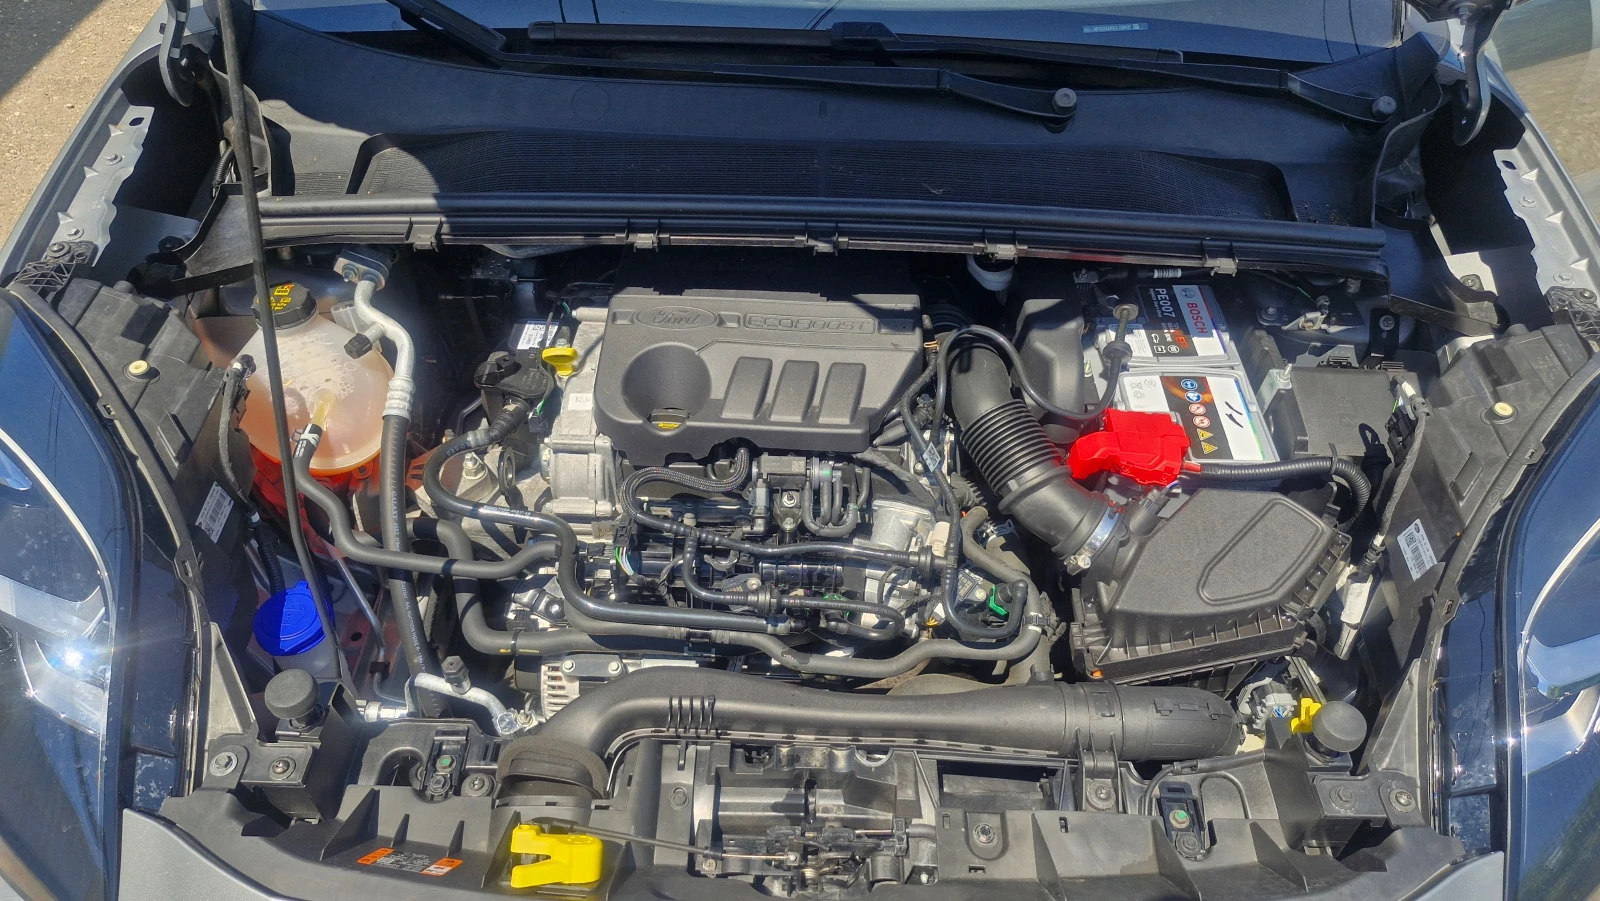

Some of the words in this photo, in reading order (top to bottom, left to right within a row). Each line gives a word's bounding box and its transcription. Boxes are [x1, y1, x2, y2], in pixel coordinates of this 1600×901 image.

[653, 310, 701, 325] Ford
[1155, 288, 1176, 318] PE007
[747, 316, 871, 331] ECOBOOST
[1186, 302, 1207, 334] BOSCH
[391, 491, 399, 520] GALAXY
